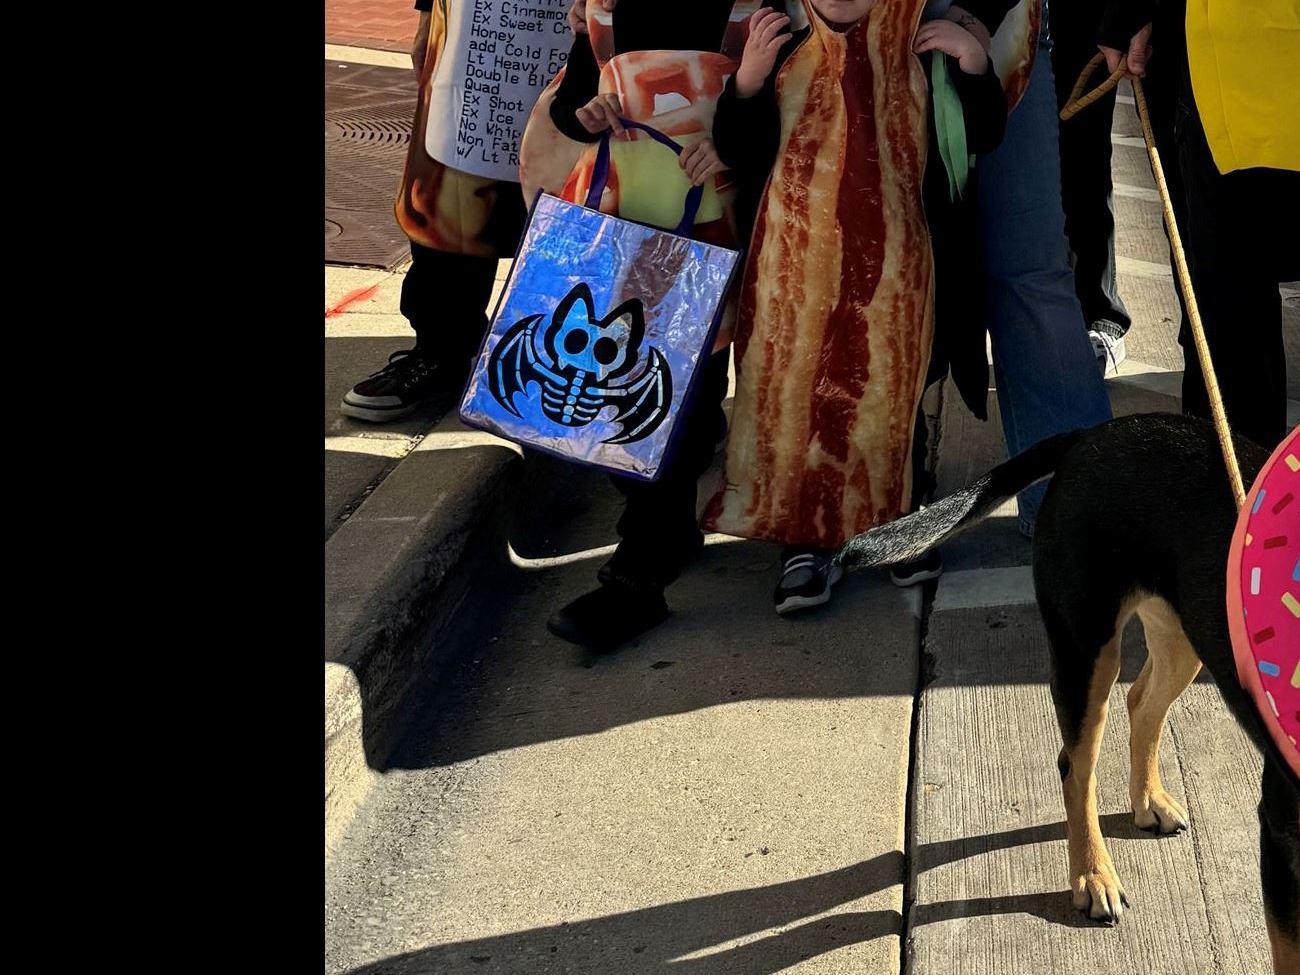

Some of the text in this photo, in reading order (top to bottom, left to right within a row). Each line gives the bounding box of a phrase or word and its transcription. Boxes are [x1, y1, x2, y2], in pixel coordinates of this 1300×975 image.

[471, 23, 516, 43] Honey
[472, 11, 572, 35] Ex Sweet Cr
[469, 39, 568, 61] add Cold Fo
[468, 50, 564, 75] Lt Heavy Cr
[466, 64, 520, 85] Double
[465, 77, 500, 95] Quad
[464, 91, 524, 112] Ex Shot
[460, 117, 477, 131] No
[462, 104, 514, 125] Ex Ice
[458, 130, 519, 153] Non Fat
[456, 145, 474, 159] w/
[482, 149, 499, 163] Lt
